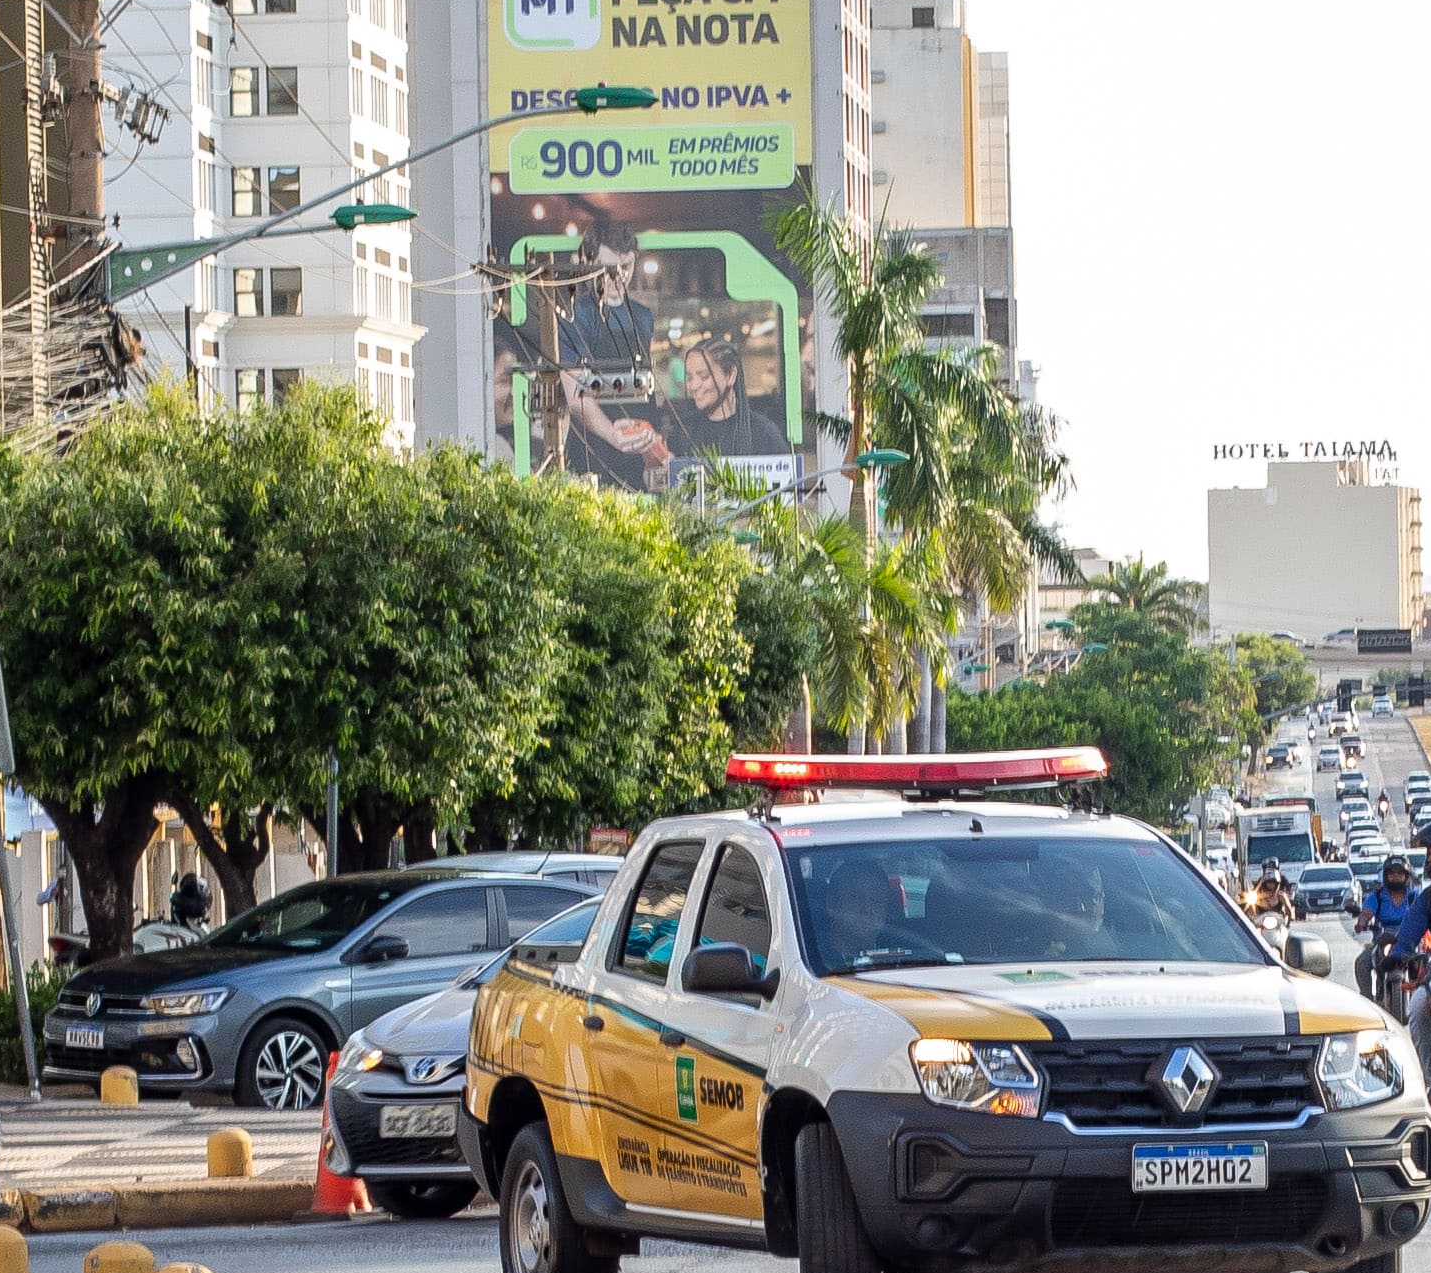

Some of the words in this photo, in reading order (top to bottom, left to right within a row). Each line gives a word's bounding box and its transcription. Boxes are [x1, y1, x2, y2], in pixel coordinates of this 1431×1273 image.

[612, 16, 667, 48] NA
[676, 13, 780, 46] NOTA
[662, 86, 699, 110] NO
[707, 84, 769, 108] IPVA
[669, 136, 696, 155] EM
[699, 132, 779, 153] PRÊMIOS
[540, 139, 623, 179] 900
[627, 148, 659, 166] MIL
[670, 158, 717, 177] TODO
[719, 155, 759, 176] MÊS
[1213, 443, 1289, 460] HOTEL
[699, 1075, 745, 1113] SEMOB
[1145, 1158, 1252, 1185] SPM2H02
